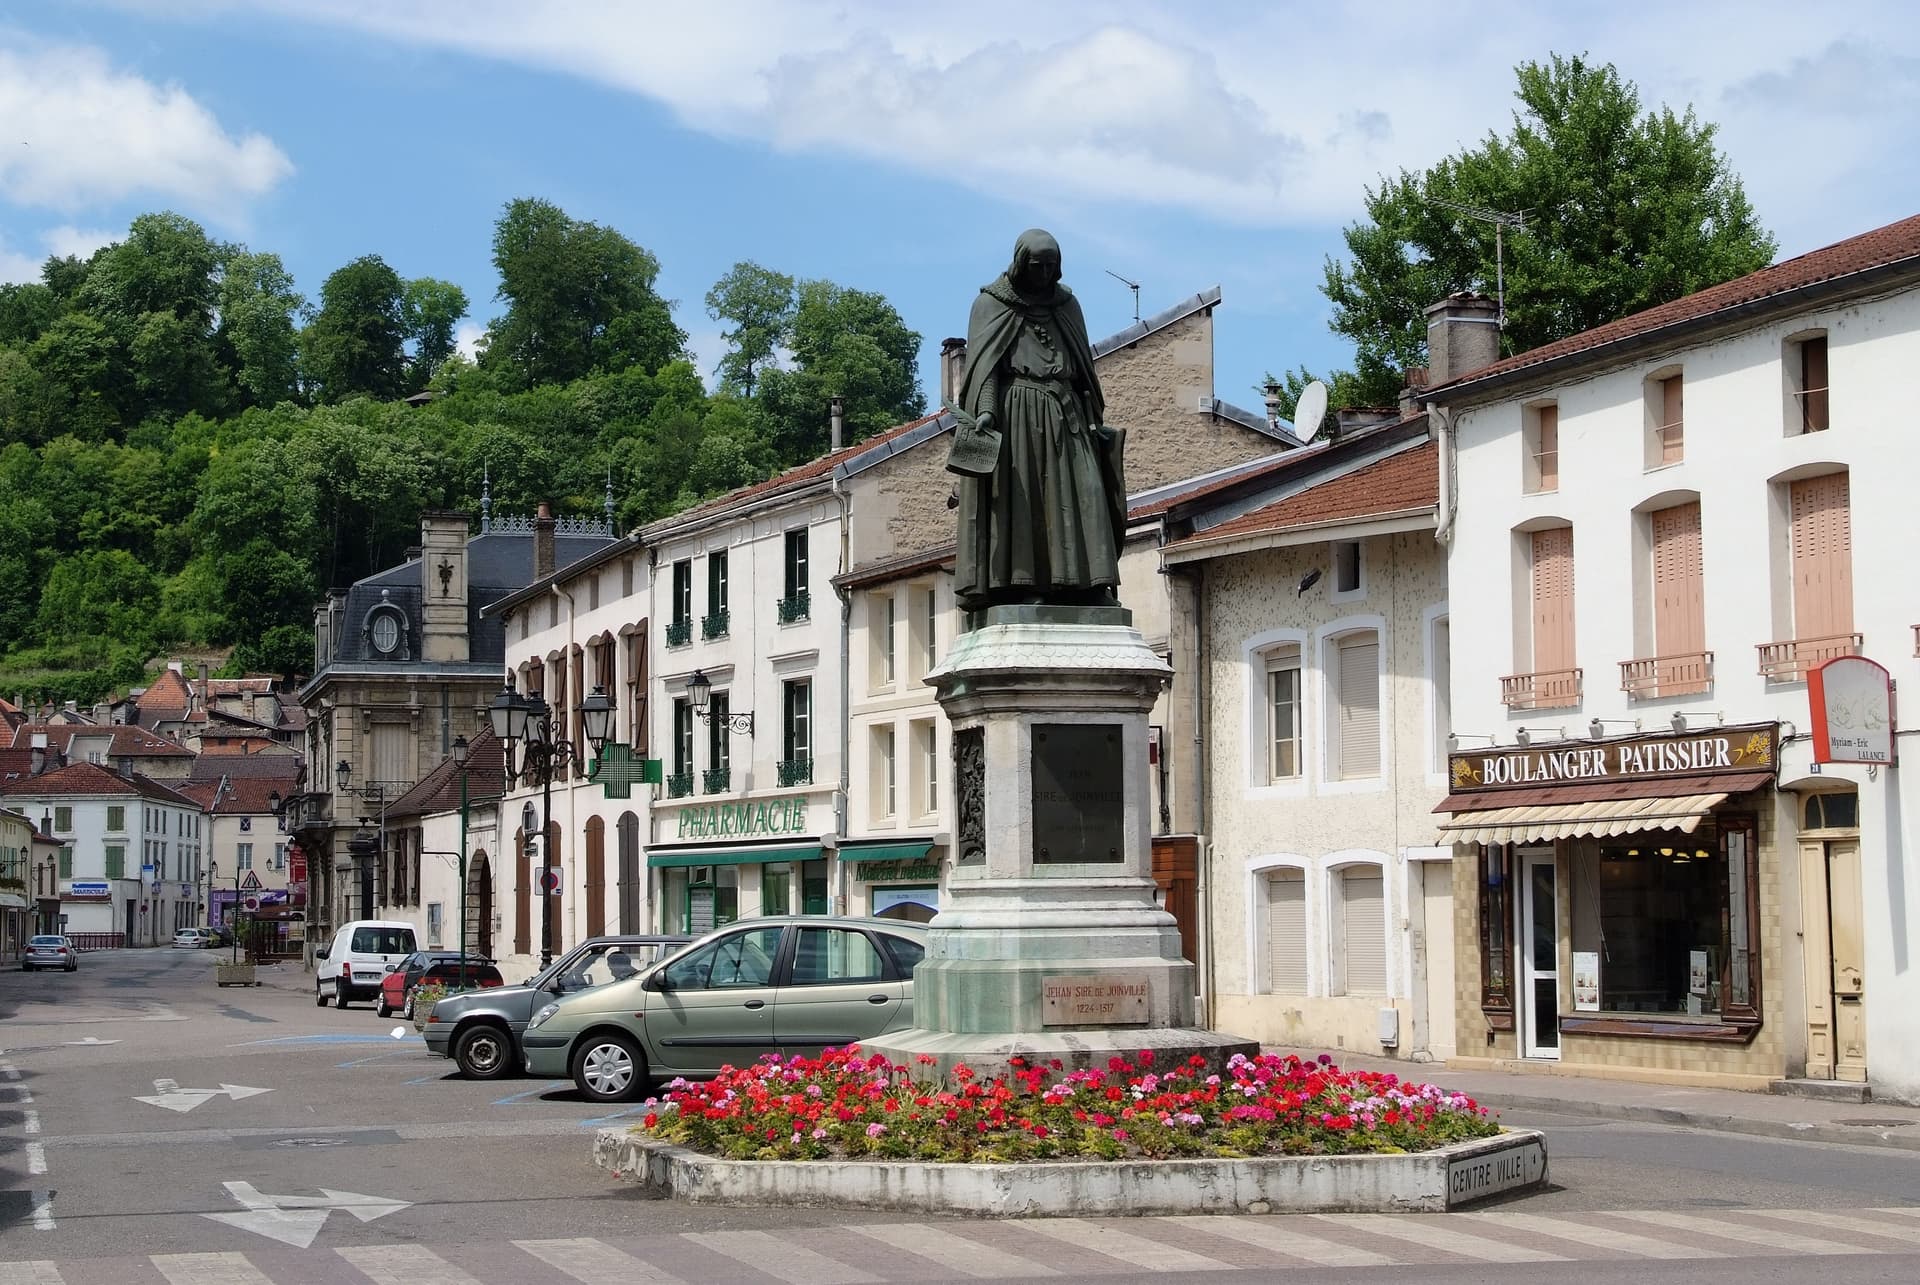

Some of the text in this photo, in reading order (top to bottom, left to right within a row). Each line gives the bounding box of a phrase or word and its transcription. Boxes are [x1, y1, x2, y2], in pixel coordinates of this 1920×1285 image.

[1831, 736, 1853, 748] Myriam
[1857, 738, 1869, 748] Eric
[1482, 737, 1732, 786] BOULANGER PATISSIER
[1858, 751, 1885, 760] LALANCE
[677, 799, 807, 839] PHARMACIE
[1046, 987, 1072, 998] JEHAN
[1075, 986, 1094, 997] SIRE
[1107, 985, 1146, 996] JOINVILLE
[1453, 1155, 1521, 1194] CENTRE VILLE
